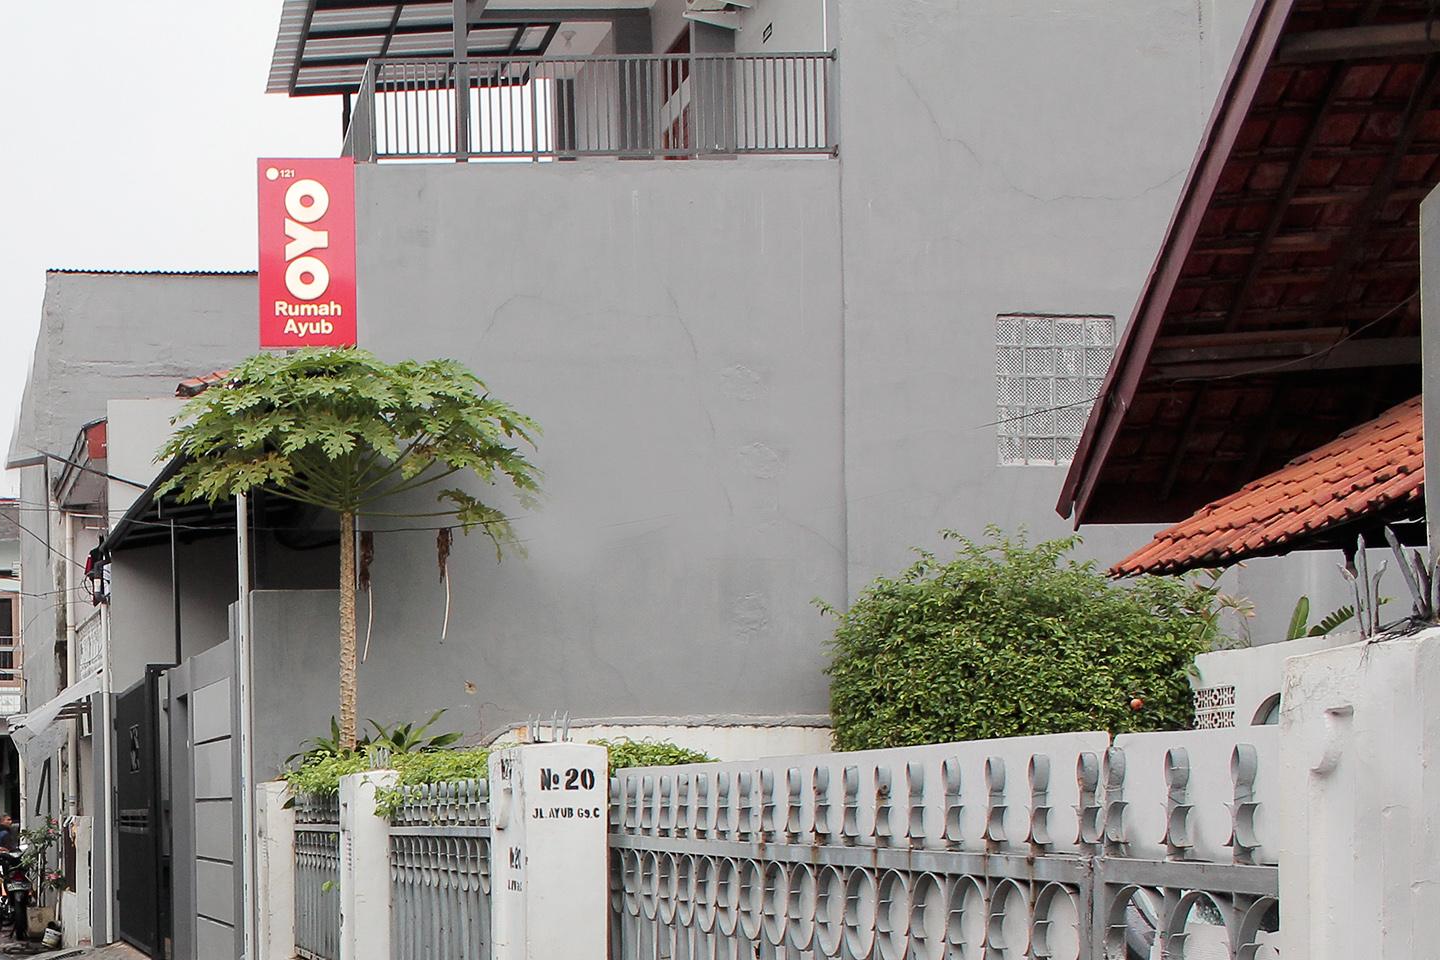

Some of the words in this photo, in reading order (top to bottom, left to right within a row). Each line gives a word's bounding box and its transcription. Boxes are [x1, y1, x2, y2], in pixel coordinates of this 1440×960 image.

[279, 169, 295, 178] 121
[284, 179, 330, 301] OYO
[274, 301, 342, 317] Rumah
[283, 319, 334, 337] Ayub
[565, 768, 596, 791] 20
